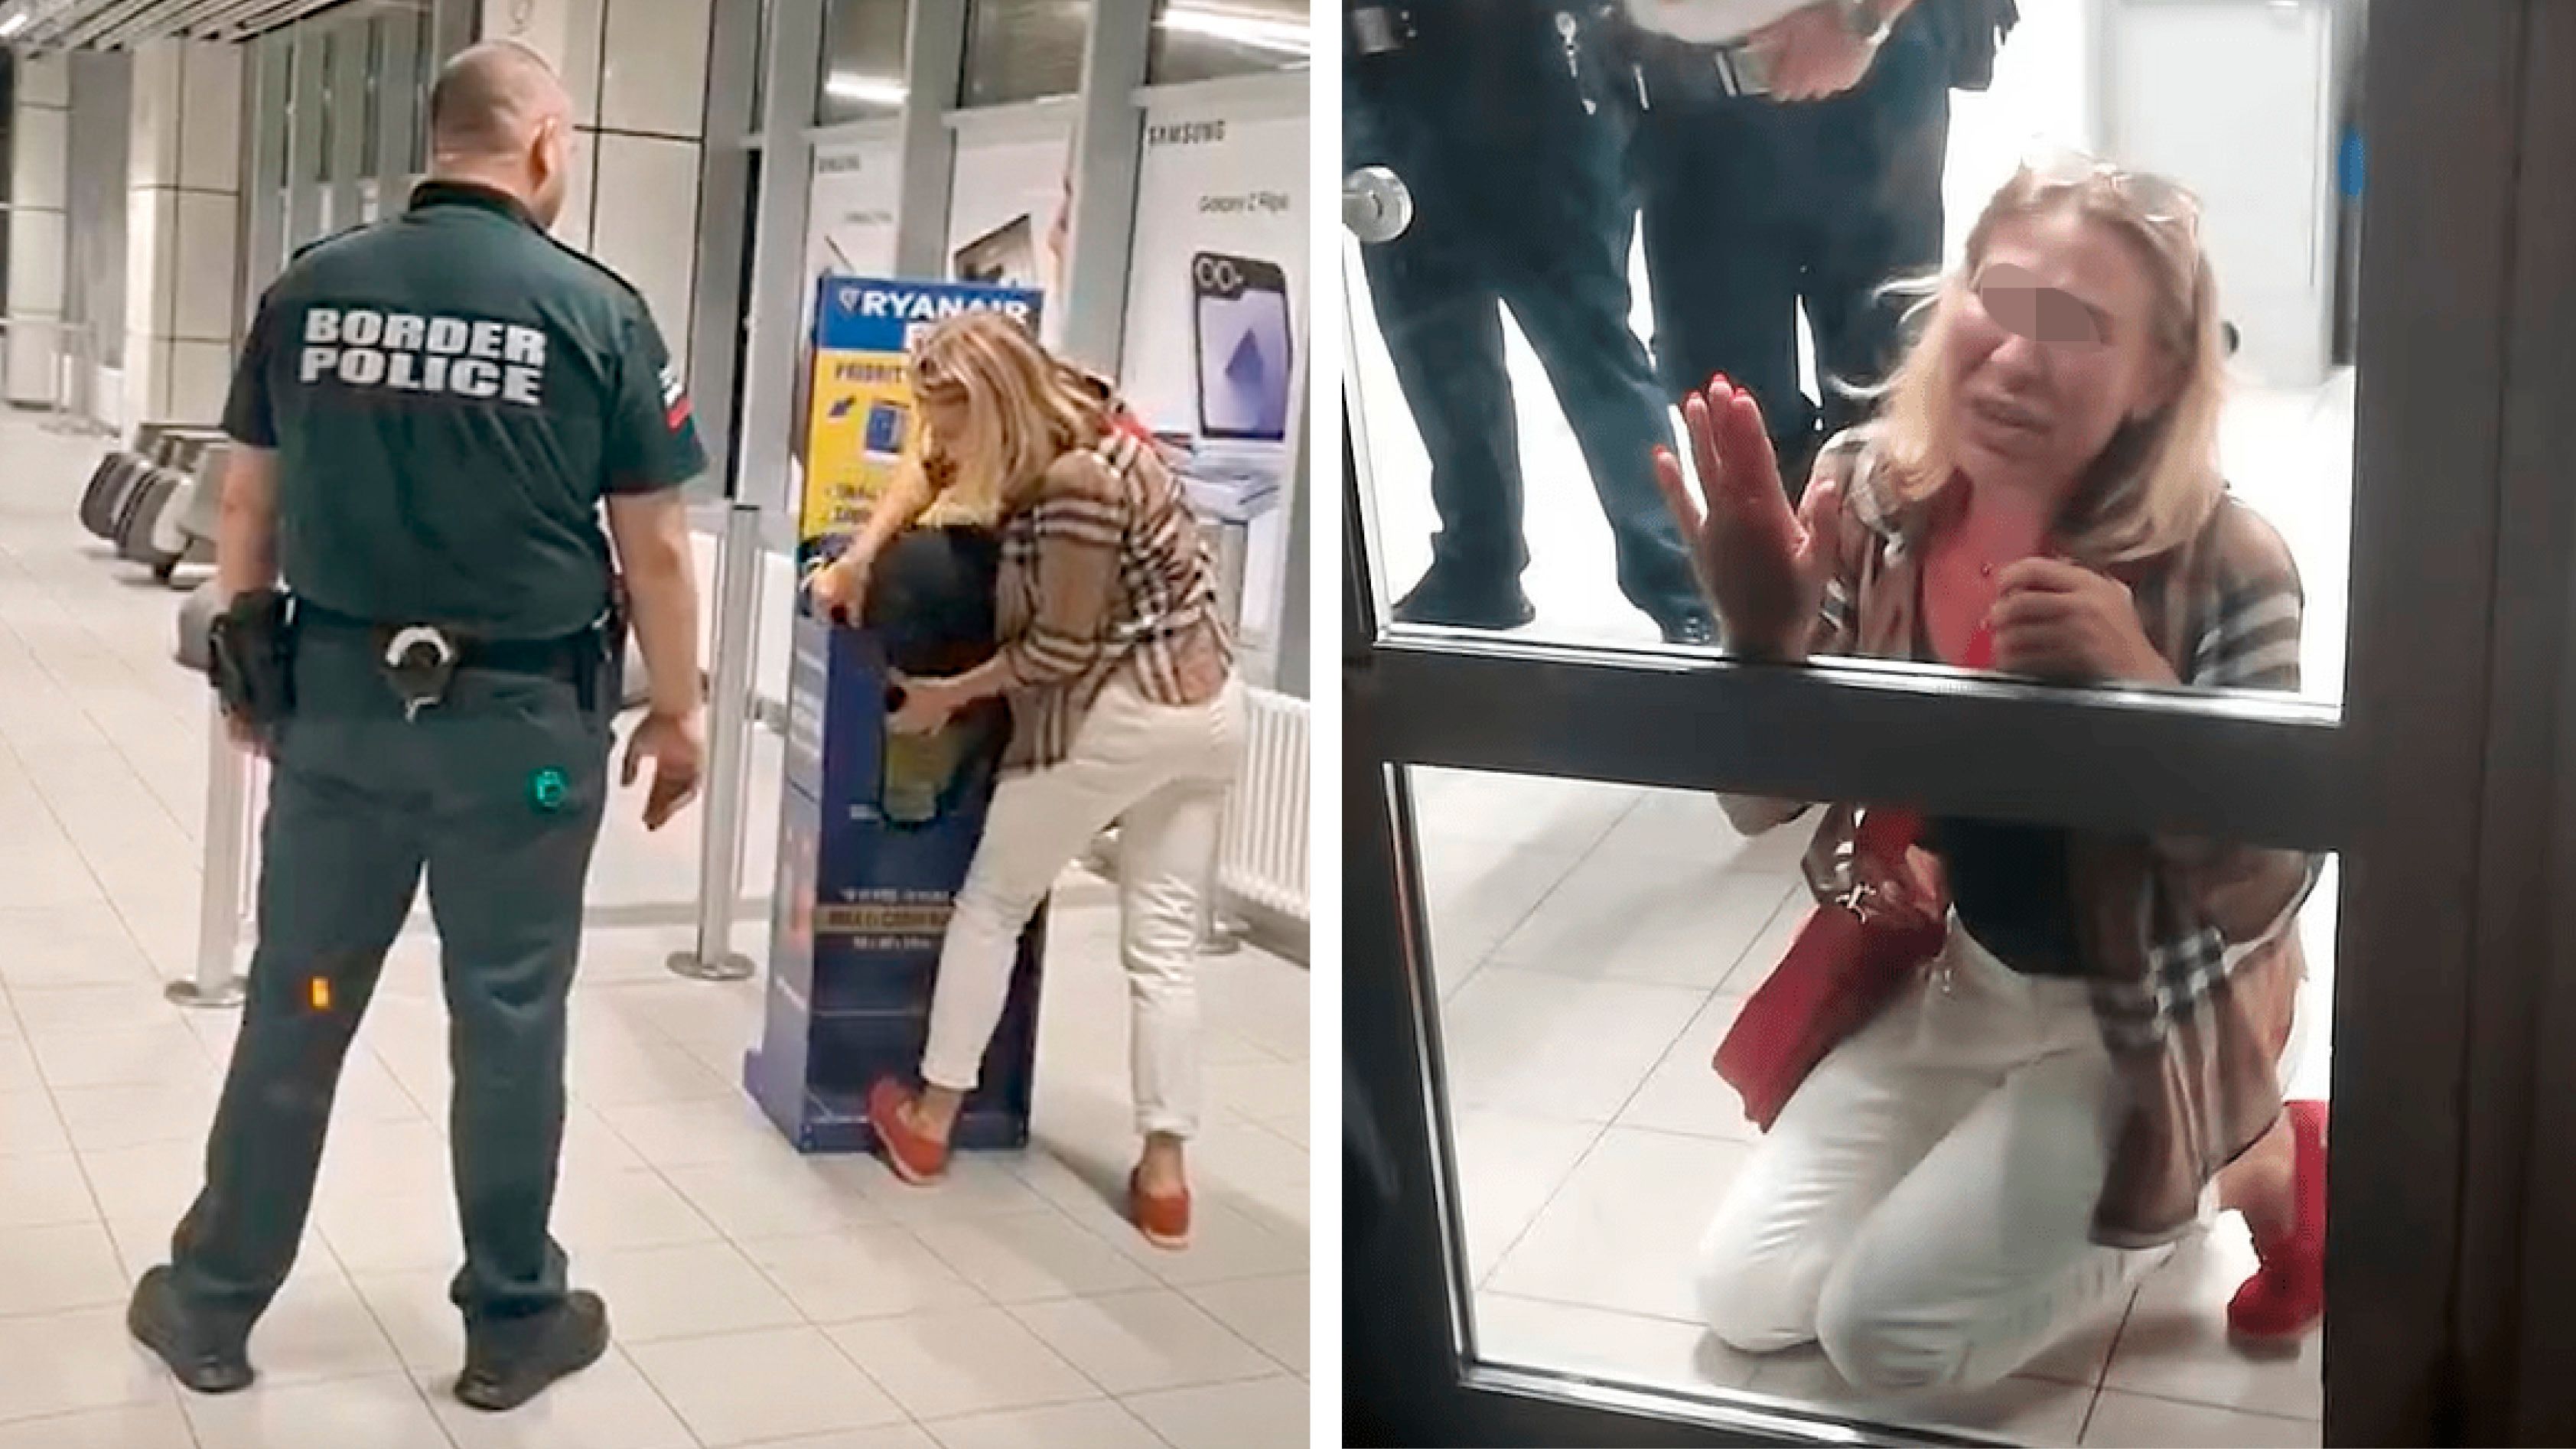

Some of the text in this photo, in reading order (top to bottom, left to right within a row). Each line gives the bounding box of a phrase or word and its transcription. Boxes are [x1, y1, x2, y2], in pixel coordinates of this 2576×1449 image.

[1149, 120, 1225, 145] SAMSUNG
[304, 308, 546, 366] BORDER
[301, 347, 542, 405] POLICE
[835, 362, 905, 383] PRIORIT
